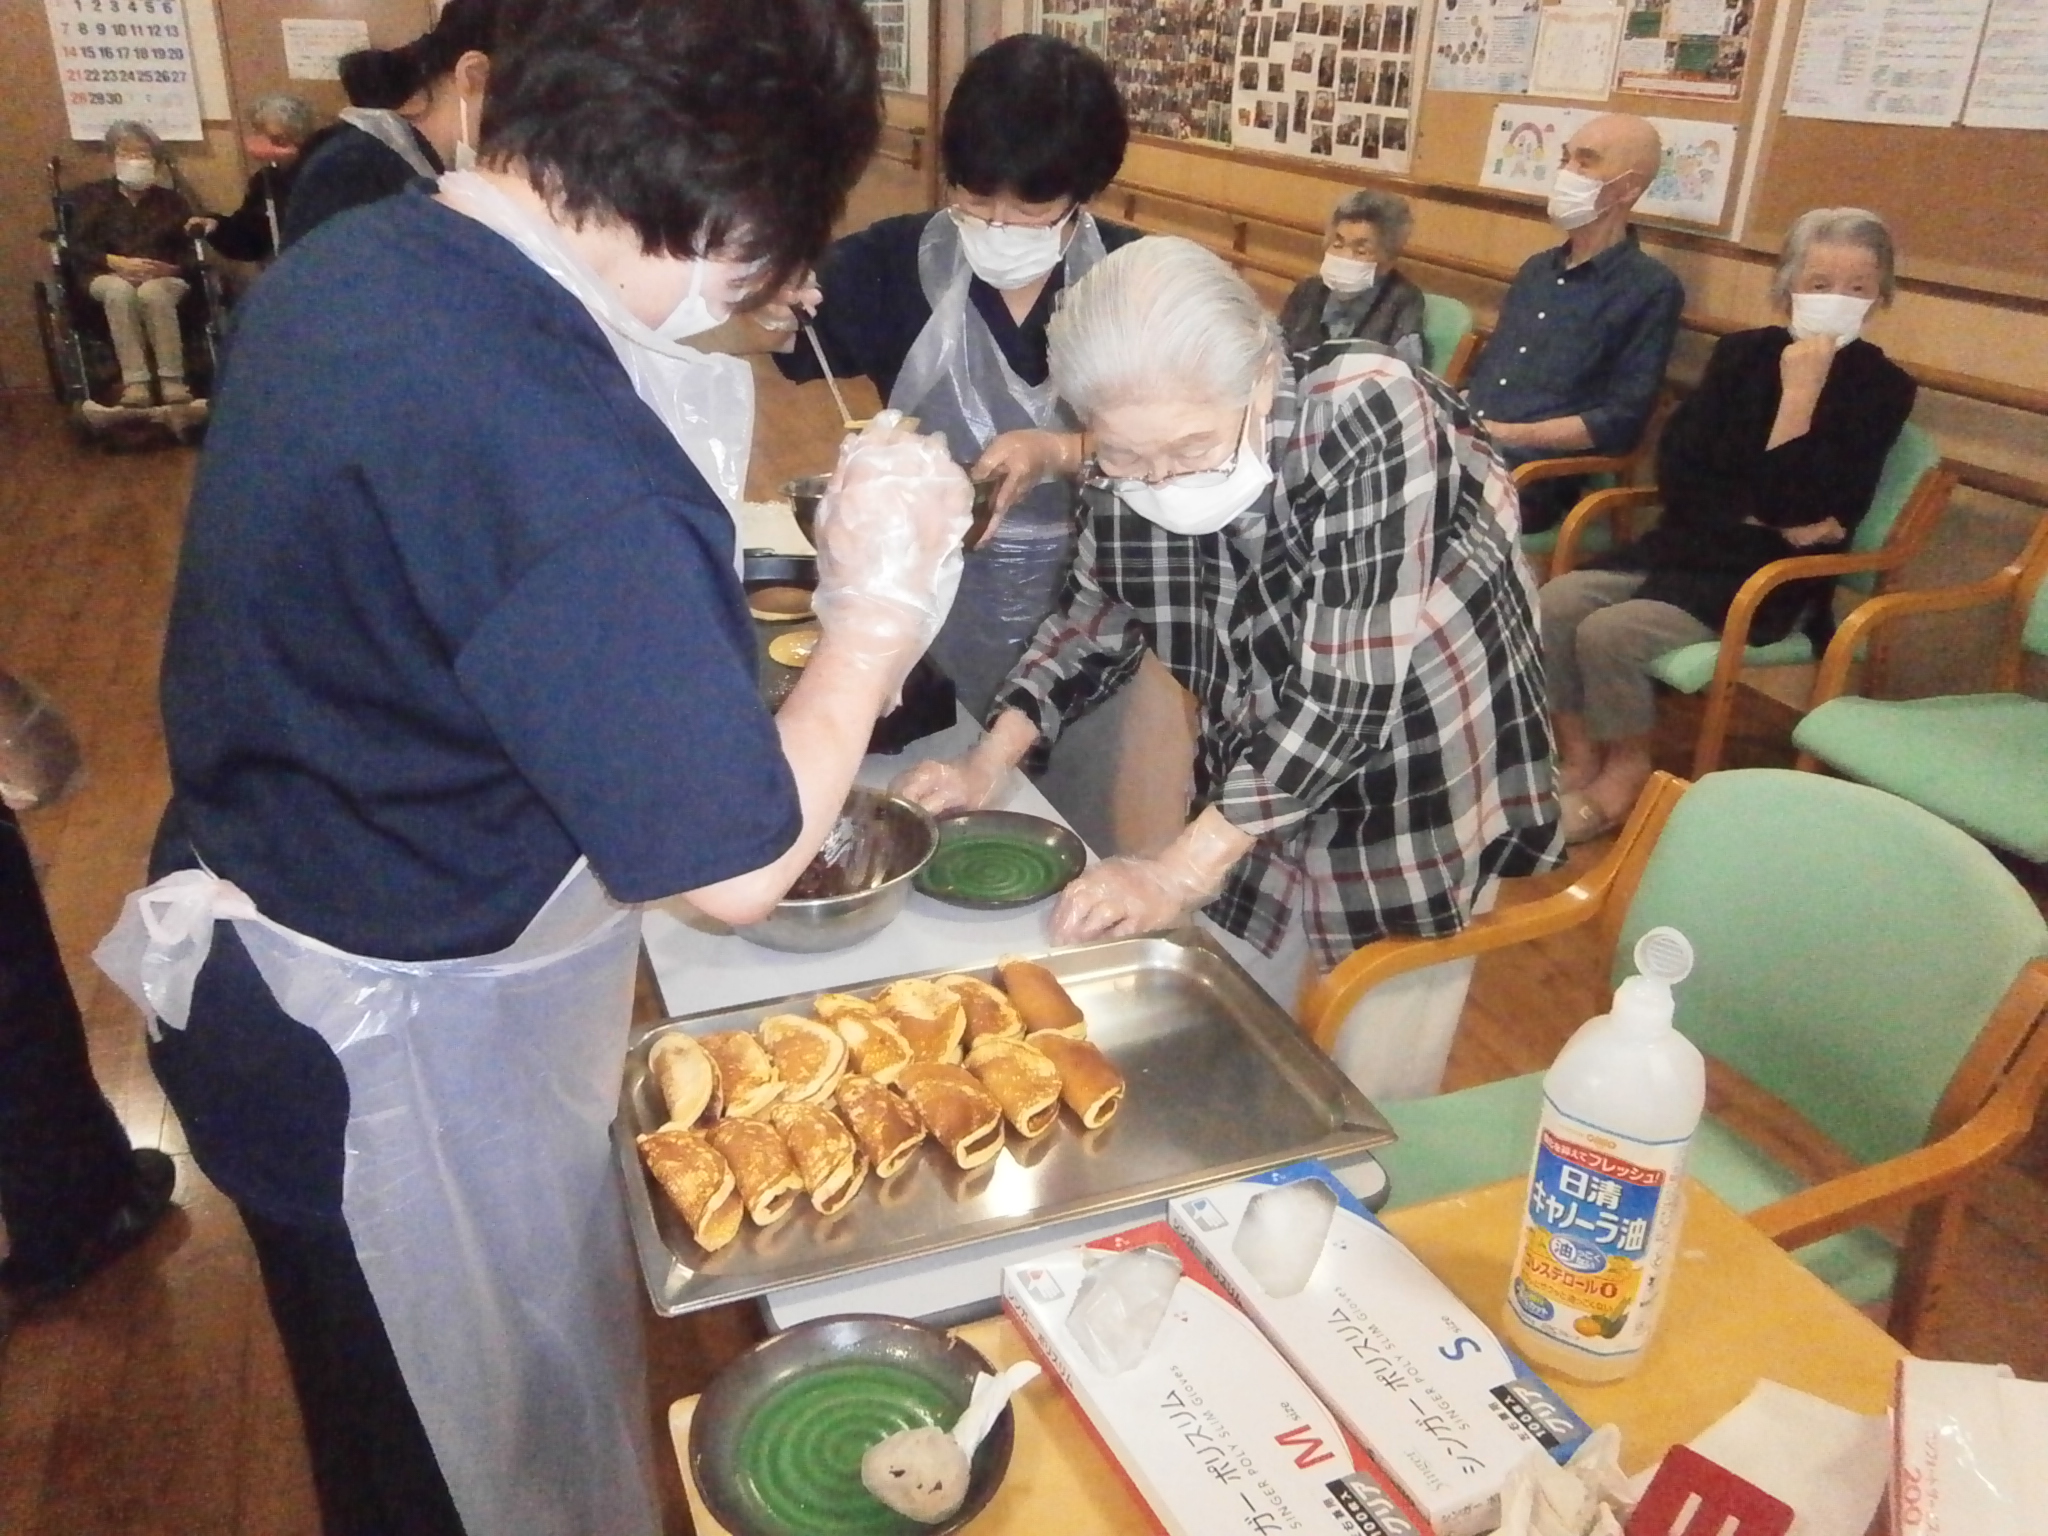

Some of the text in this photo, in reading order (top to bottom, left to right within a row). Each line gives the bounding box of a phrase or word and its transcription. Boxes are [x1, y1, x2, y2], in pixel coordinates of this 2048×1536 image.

[60, 22, 179, 37] 7 8 9 10 11 12 13
[92, 0, 102, 12] 2
[110, 0, 120, 13] 3
[127, 1, 137, 13] 4
[144, 1, 155, 14] 5
[162, 2, 172, 14] 6
[62, 46, 184, 60] 14 15 16 17 18 19 20
[67, 69, 187, 83] 21 22 23 24 25 26 27
[70, 92, 123, 105] 28 29 30
[1559, 1165, 1623, 1211] 日清
[1532, 1179, 1648, 1252] キャノーラ油
[1334, 1286, 1470, 1431] SINGER POLY SLIM Gloves
[1438, 1315, 1482, 1361] S size
[1328, 1307, 1486, 1475] シンガー ポリスリム
[1513, 1386, 1574, 1434] クリア
[1160, 1389, 1241, 1485] ポリスリム
[1274, 1400, 1336, 1470] M size
[1488, 1401, 1531, 1442] 左右兼用
[1502, 1394, 1548, 1439] 100枚入
[1170, 1364, 1302, 1530] SINGER POLY SLIM Gloves
[1323, 1497, 1361, 1536] 右兼用
[1340, 1491, 1382, 1536] 100枚入
[1350, 1481, 1412, 1534] クリア
[1903, 1467, 1923, 1526] 200
